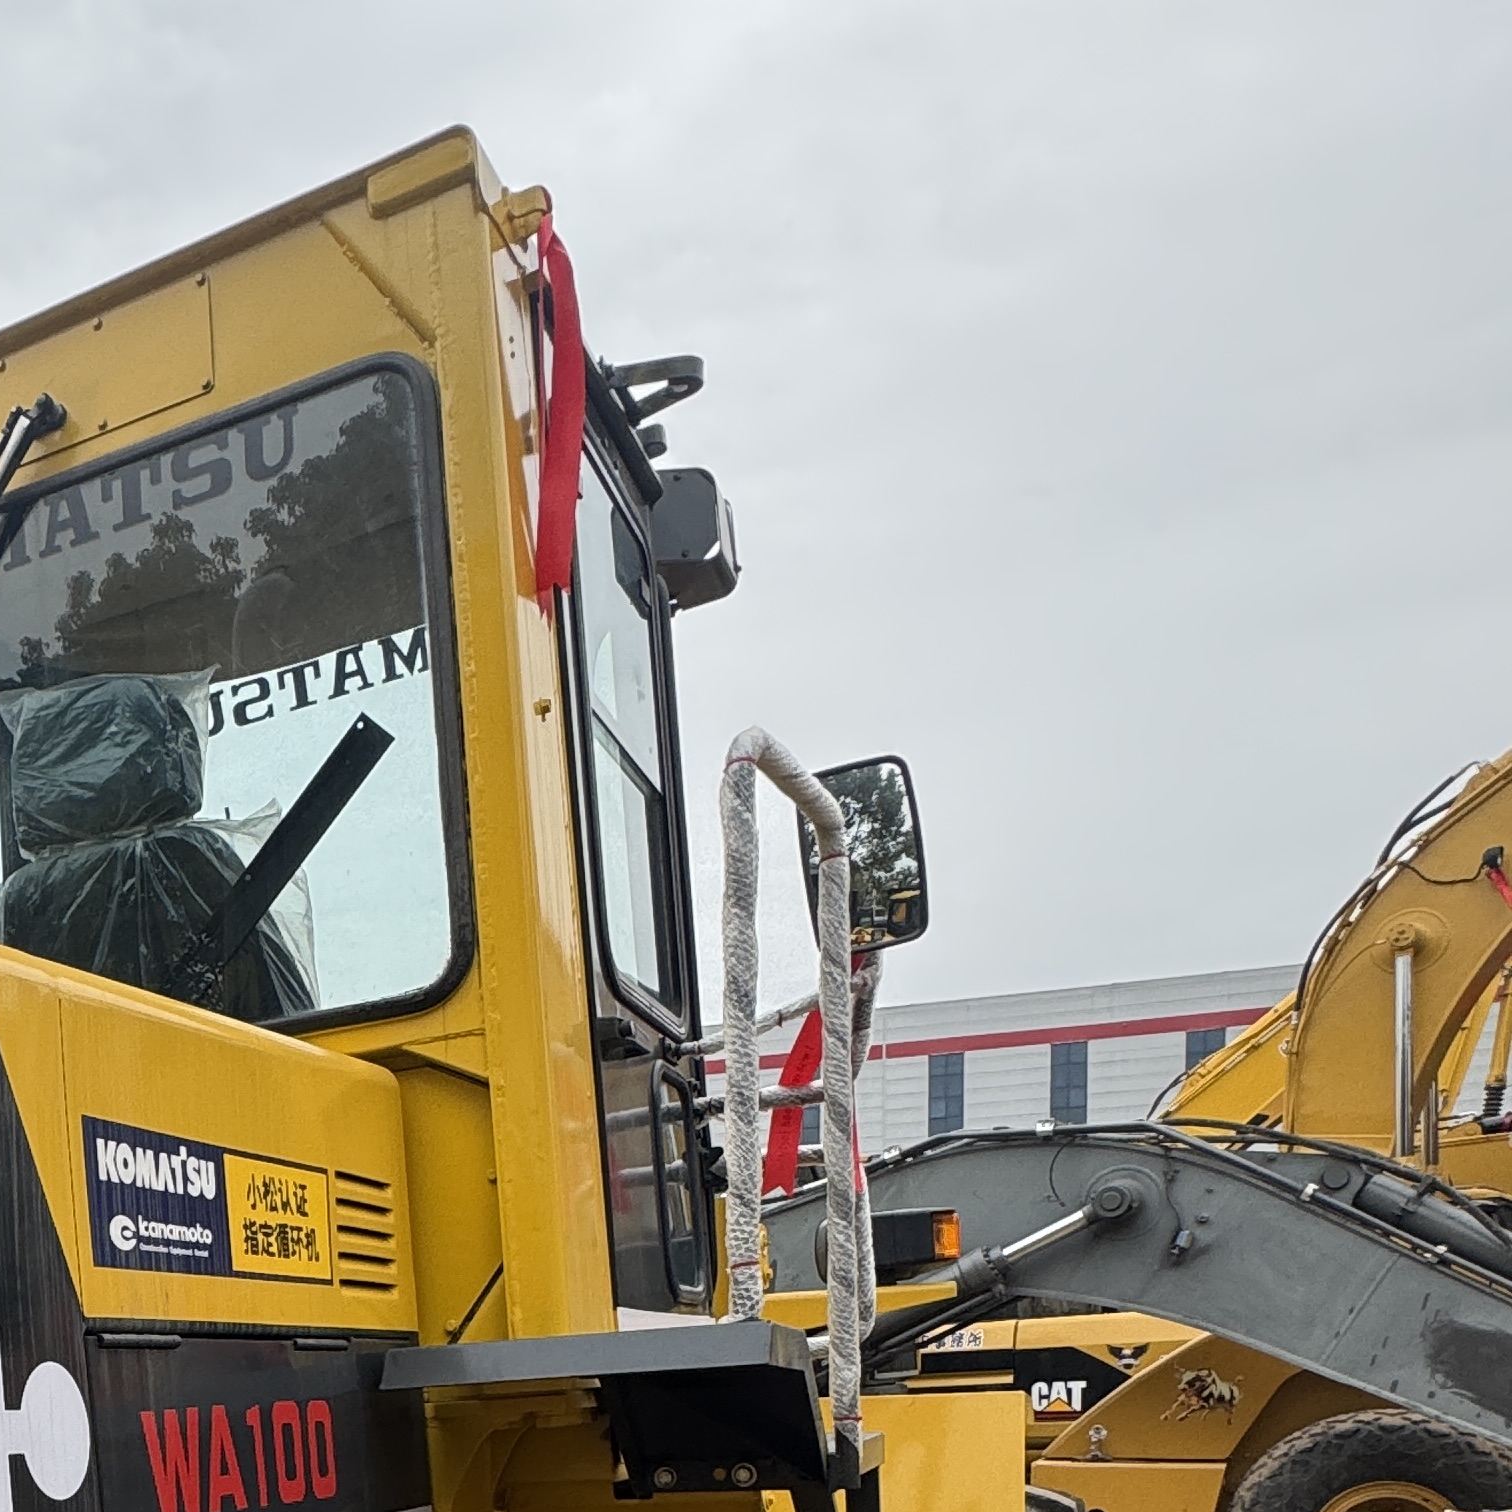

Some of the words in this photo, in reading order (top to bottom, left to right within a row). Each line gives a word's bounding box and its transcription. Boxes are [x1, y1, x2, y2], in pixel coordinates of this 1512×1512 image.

[95, 1137, 217, 1200] KOMATSU
[246, 1172, 310, 1218] 小松认证
[138, 1214, 213, 1245] kanamoto
[242, 1217, 320, 1263] 指定循环机
[1030, 1381, 1088, 1412] CAT
